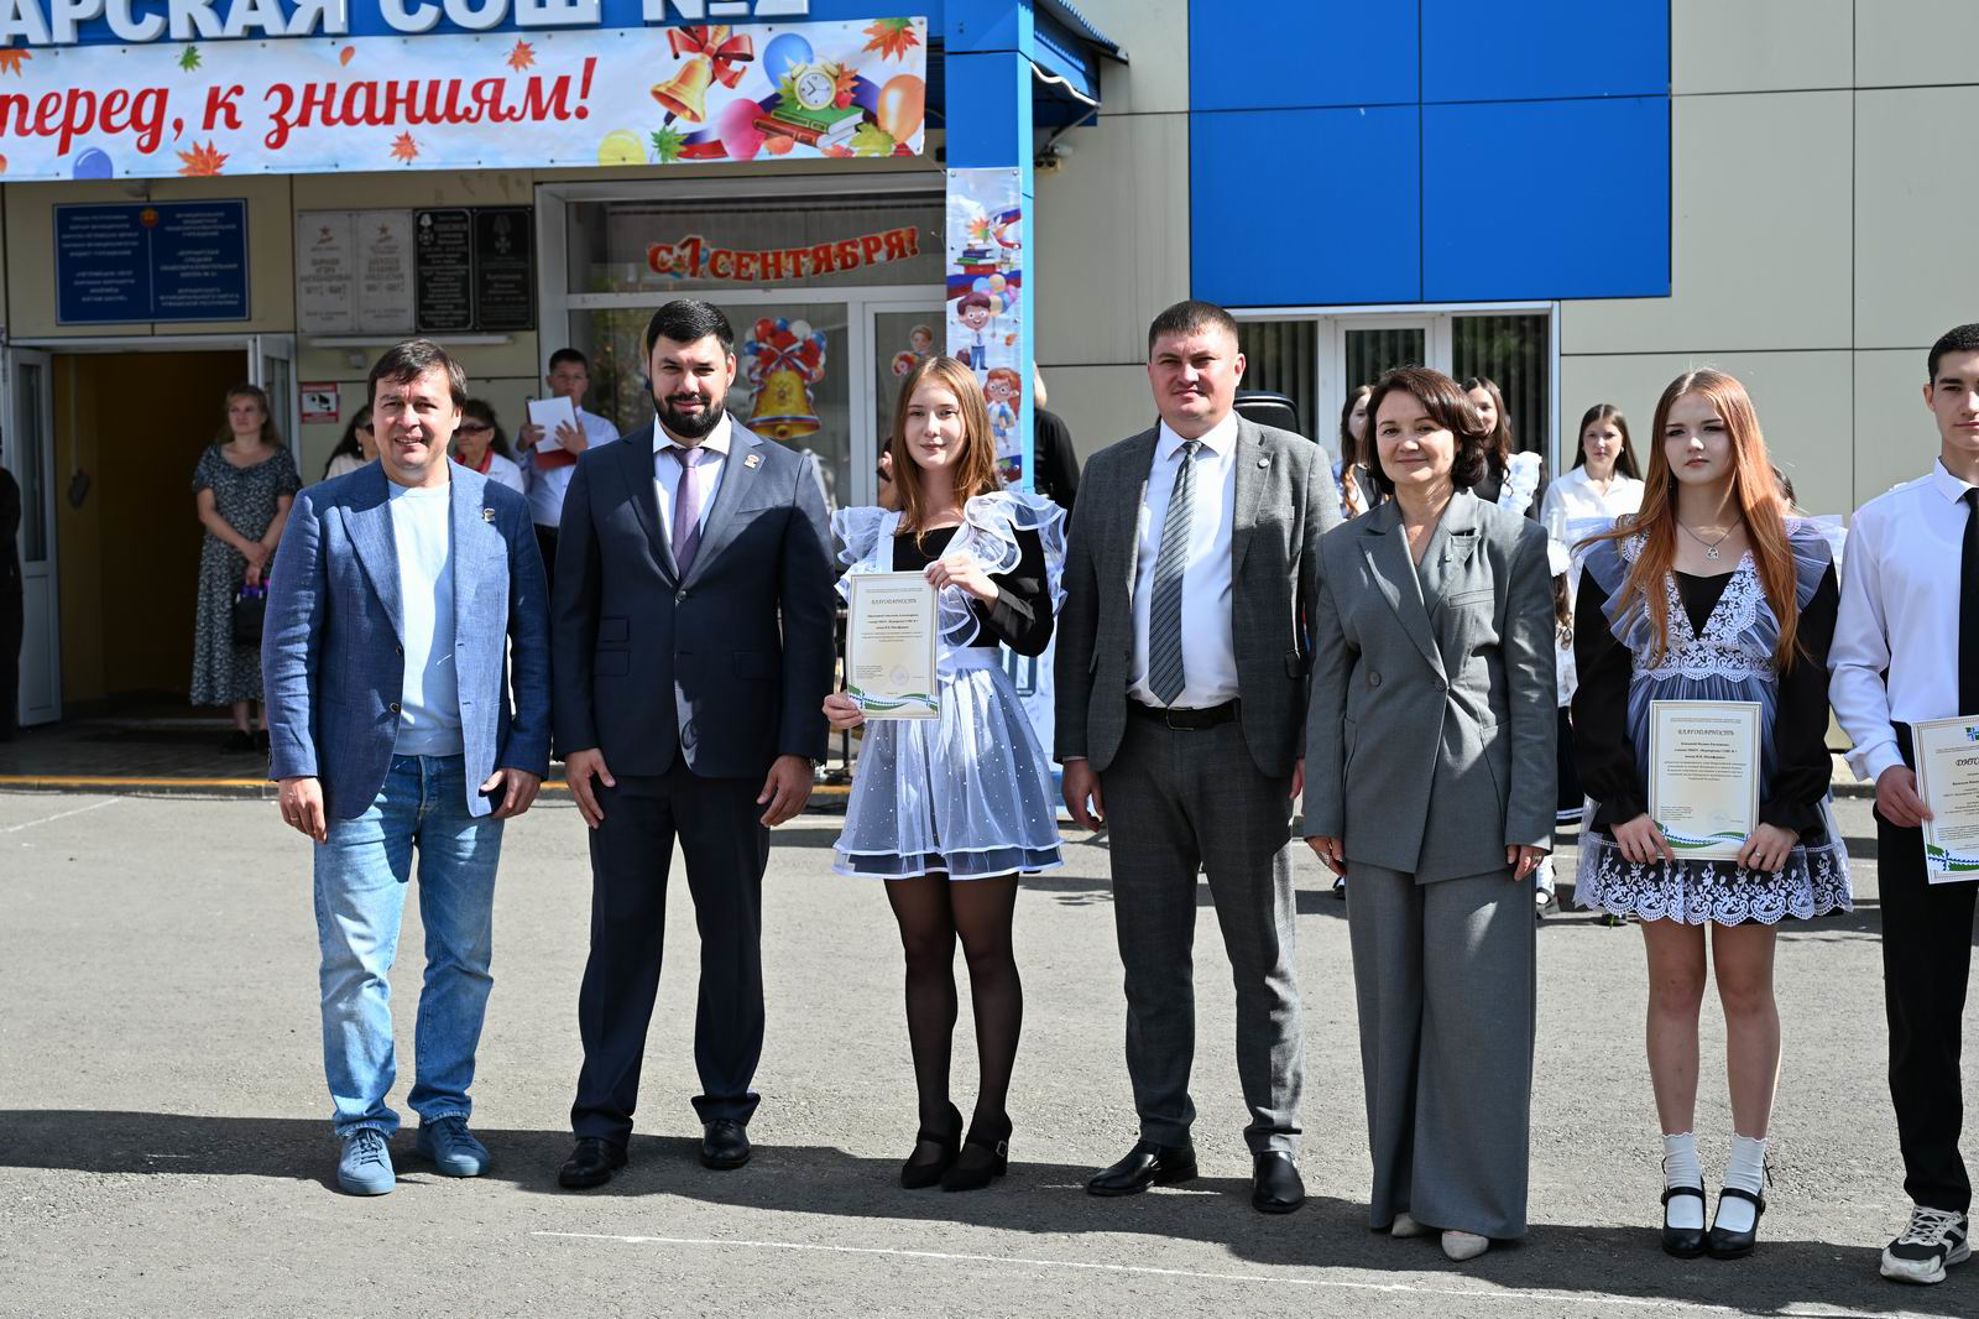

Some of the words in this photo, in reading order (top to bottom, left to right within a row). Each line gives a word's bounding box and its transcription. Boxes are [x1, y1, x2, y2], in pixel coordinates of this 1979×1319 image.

[0, 88, 184, 156] перед,
[202, 85, 245, 131] к
[263, 57, 597, 150] знаниям!
[648, 244, 675, 275] С
[679, 236, 704, 279] 1
[708, 227, 919, 282] СЕНТЯБРЯ!
